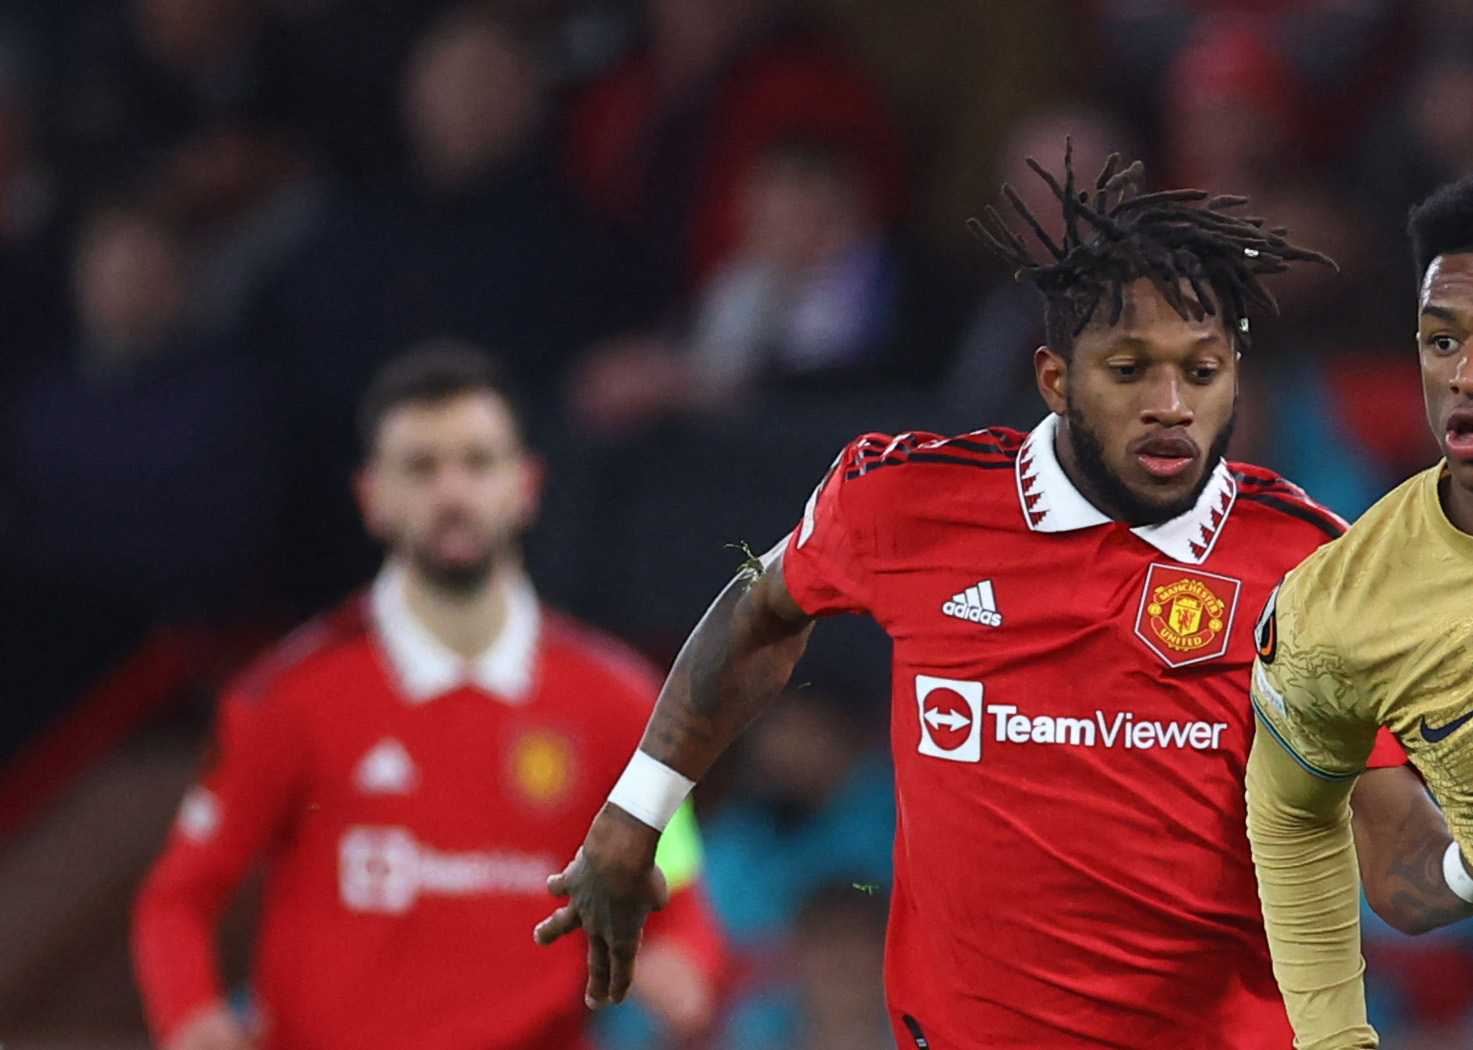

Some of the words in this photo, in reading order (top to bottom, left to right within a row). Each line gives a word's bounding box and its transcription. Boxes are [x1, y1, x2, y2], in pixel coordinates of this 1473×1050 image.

[1158, 582, 1219, 614] MANCHESTER
[942, 601, 1003, 627] adidas
[1159, 627, 1203, 647] UNITED
[986, 704, 1228, 750] TeamViewer
